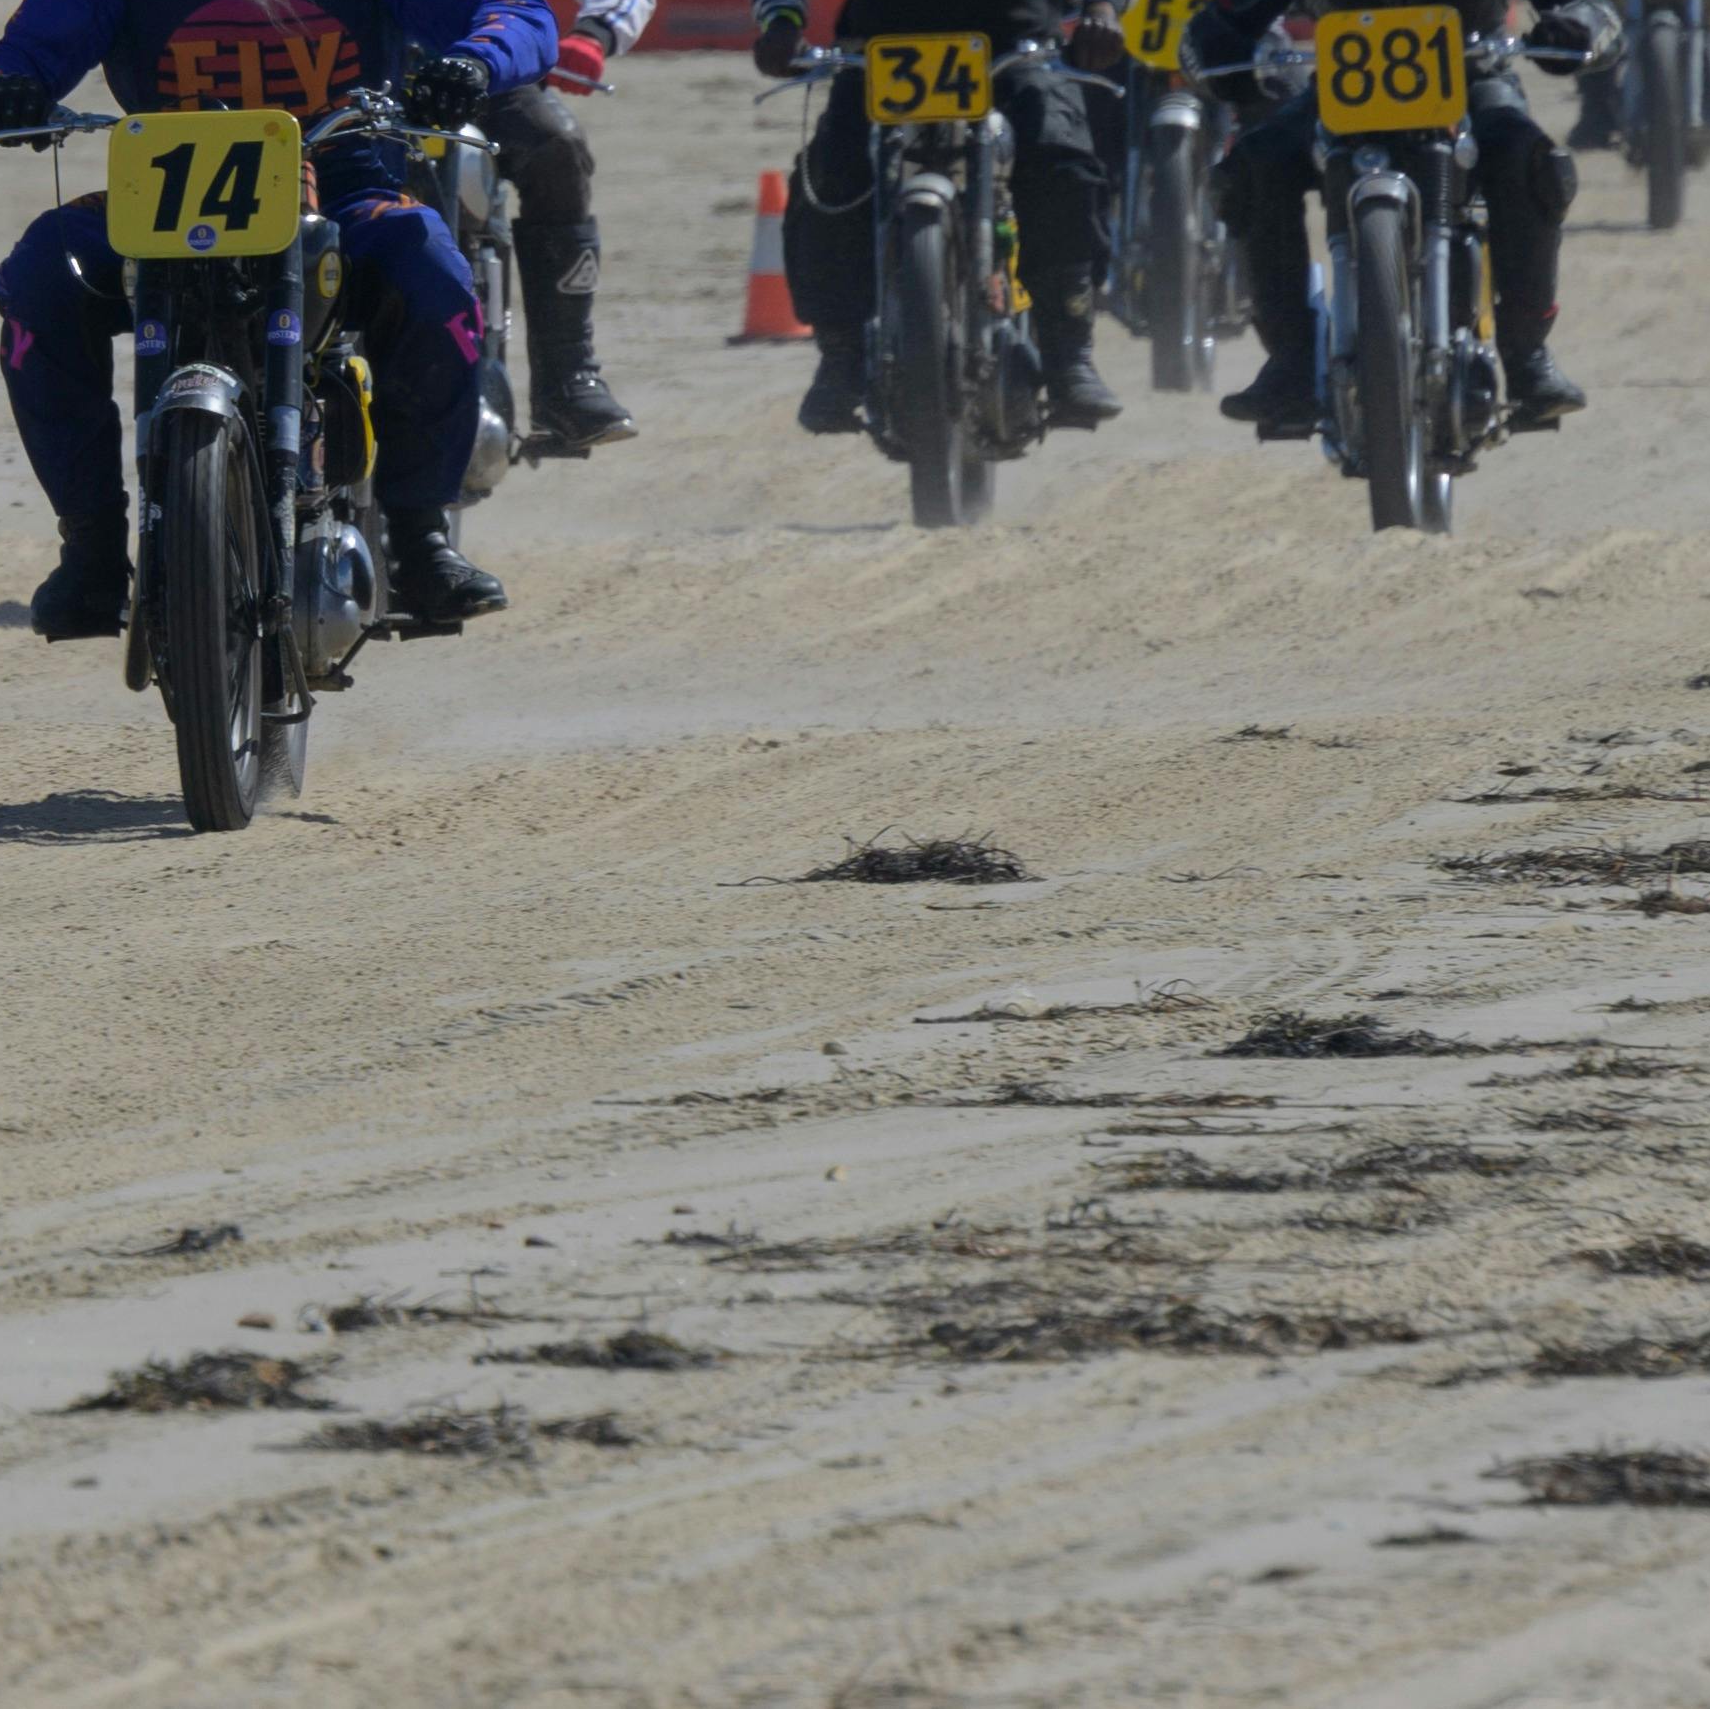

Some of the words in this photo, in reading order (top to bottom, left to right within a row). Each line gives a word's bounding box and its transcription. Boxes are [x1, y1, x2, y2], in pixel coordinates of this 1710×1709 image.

[167, 30, 340, 115] FLY
[879, 45, 980, 114] 34
[1331, 25, 1452, 108] 881
[150, 140, 265, 233] 14
